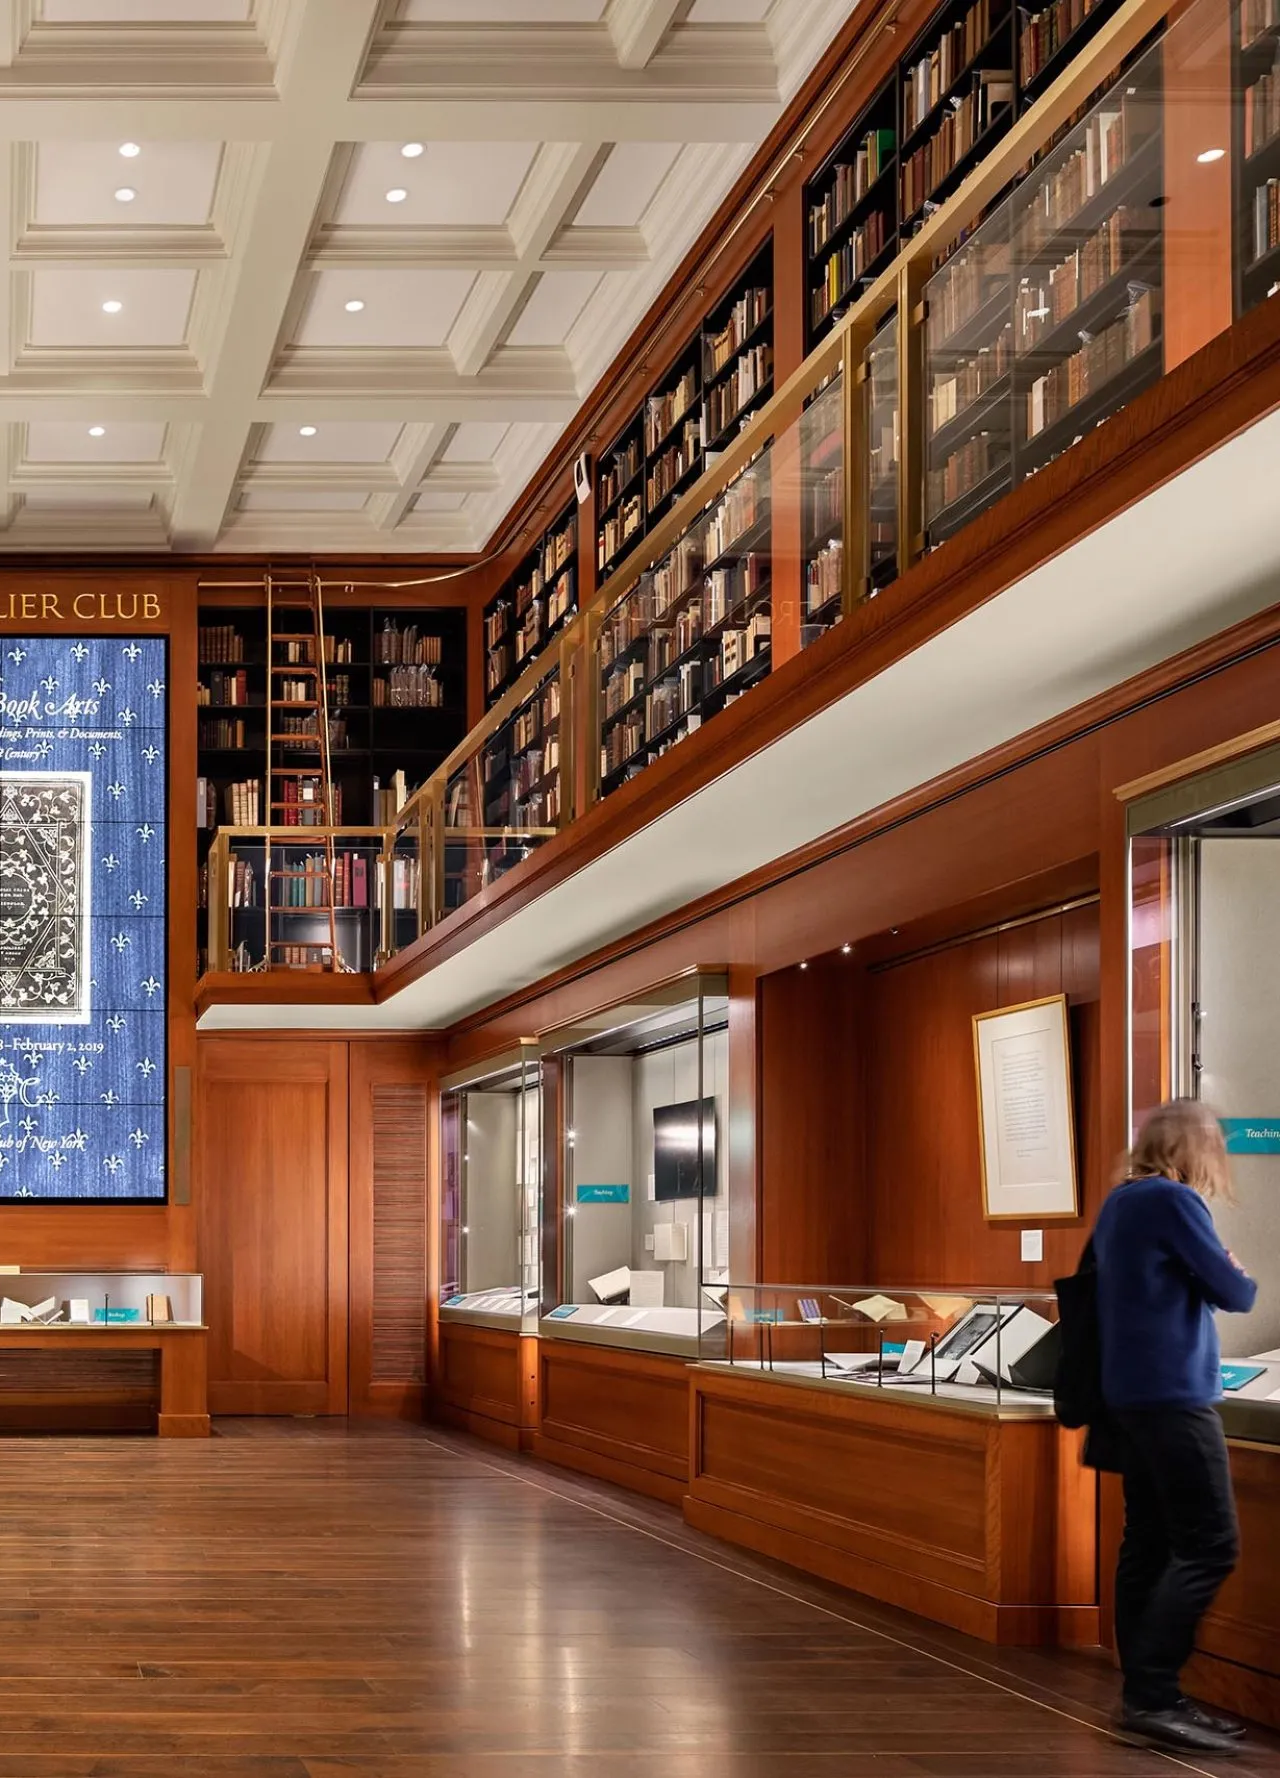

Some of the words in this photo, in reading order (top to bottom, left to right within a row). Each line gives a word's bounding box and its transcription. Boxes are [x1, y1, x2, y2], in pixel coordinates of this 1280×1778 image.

[73, 593, 161, 620] CLUB
[45, 693, 100, 716] Arts
[25, 728, 55, 740] Prints,
[58, 728, 69, 739] &
[70, 728, 123, 740] Documents,
[4, 747, 40, 762] Century
[67, 1043, 76, 1052] 2,
[79, 1041, 104, 1054] 2019
[1245, 1128, 1280, 1141] Teachin
[14, 1134, 27, 1152] of
[30, 1135, 58, 1149] New
[59, 1134, 87, 1151] York
